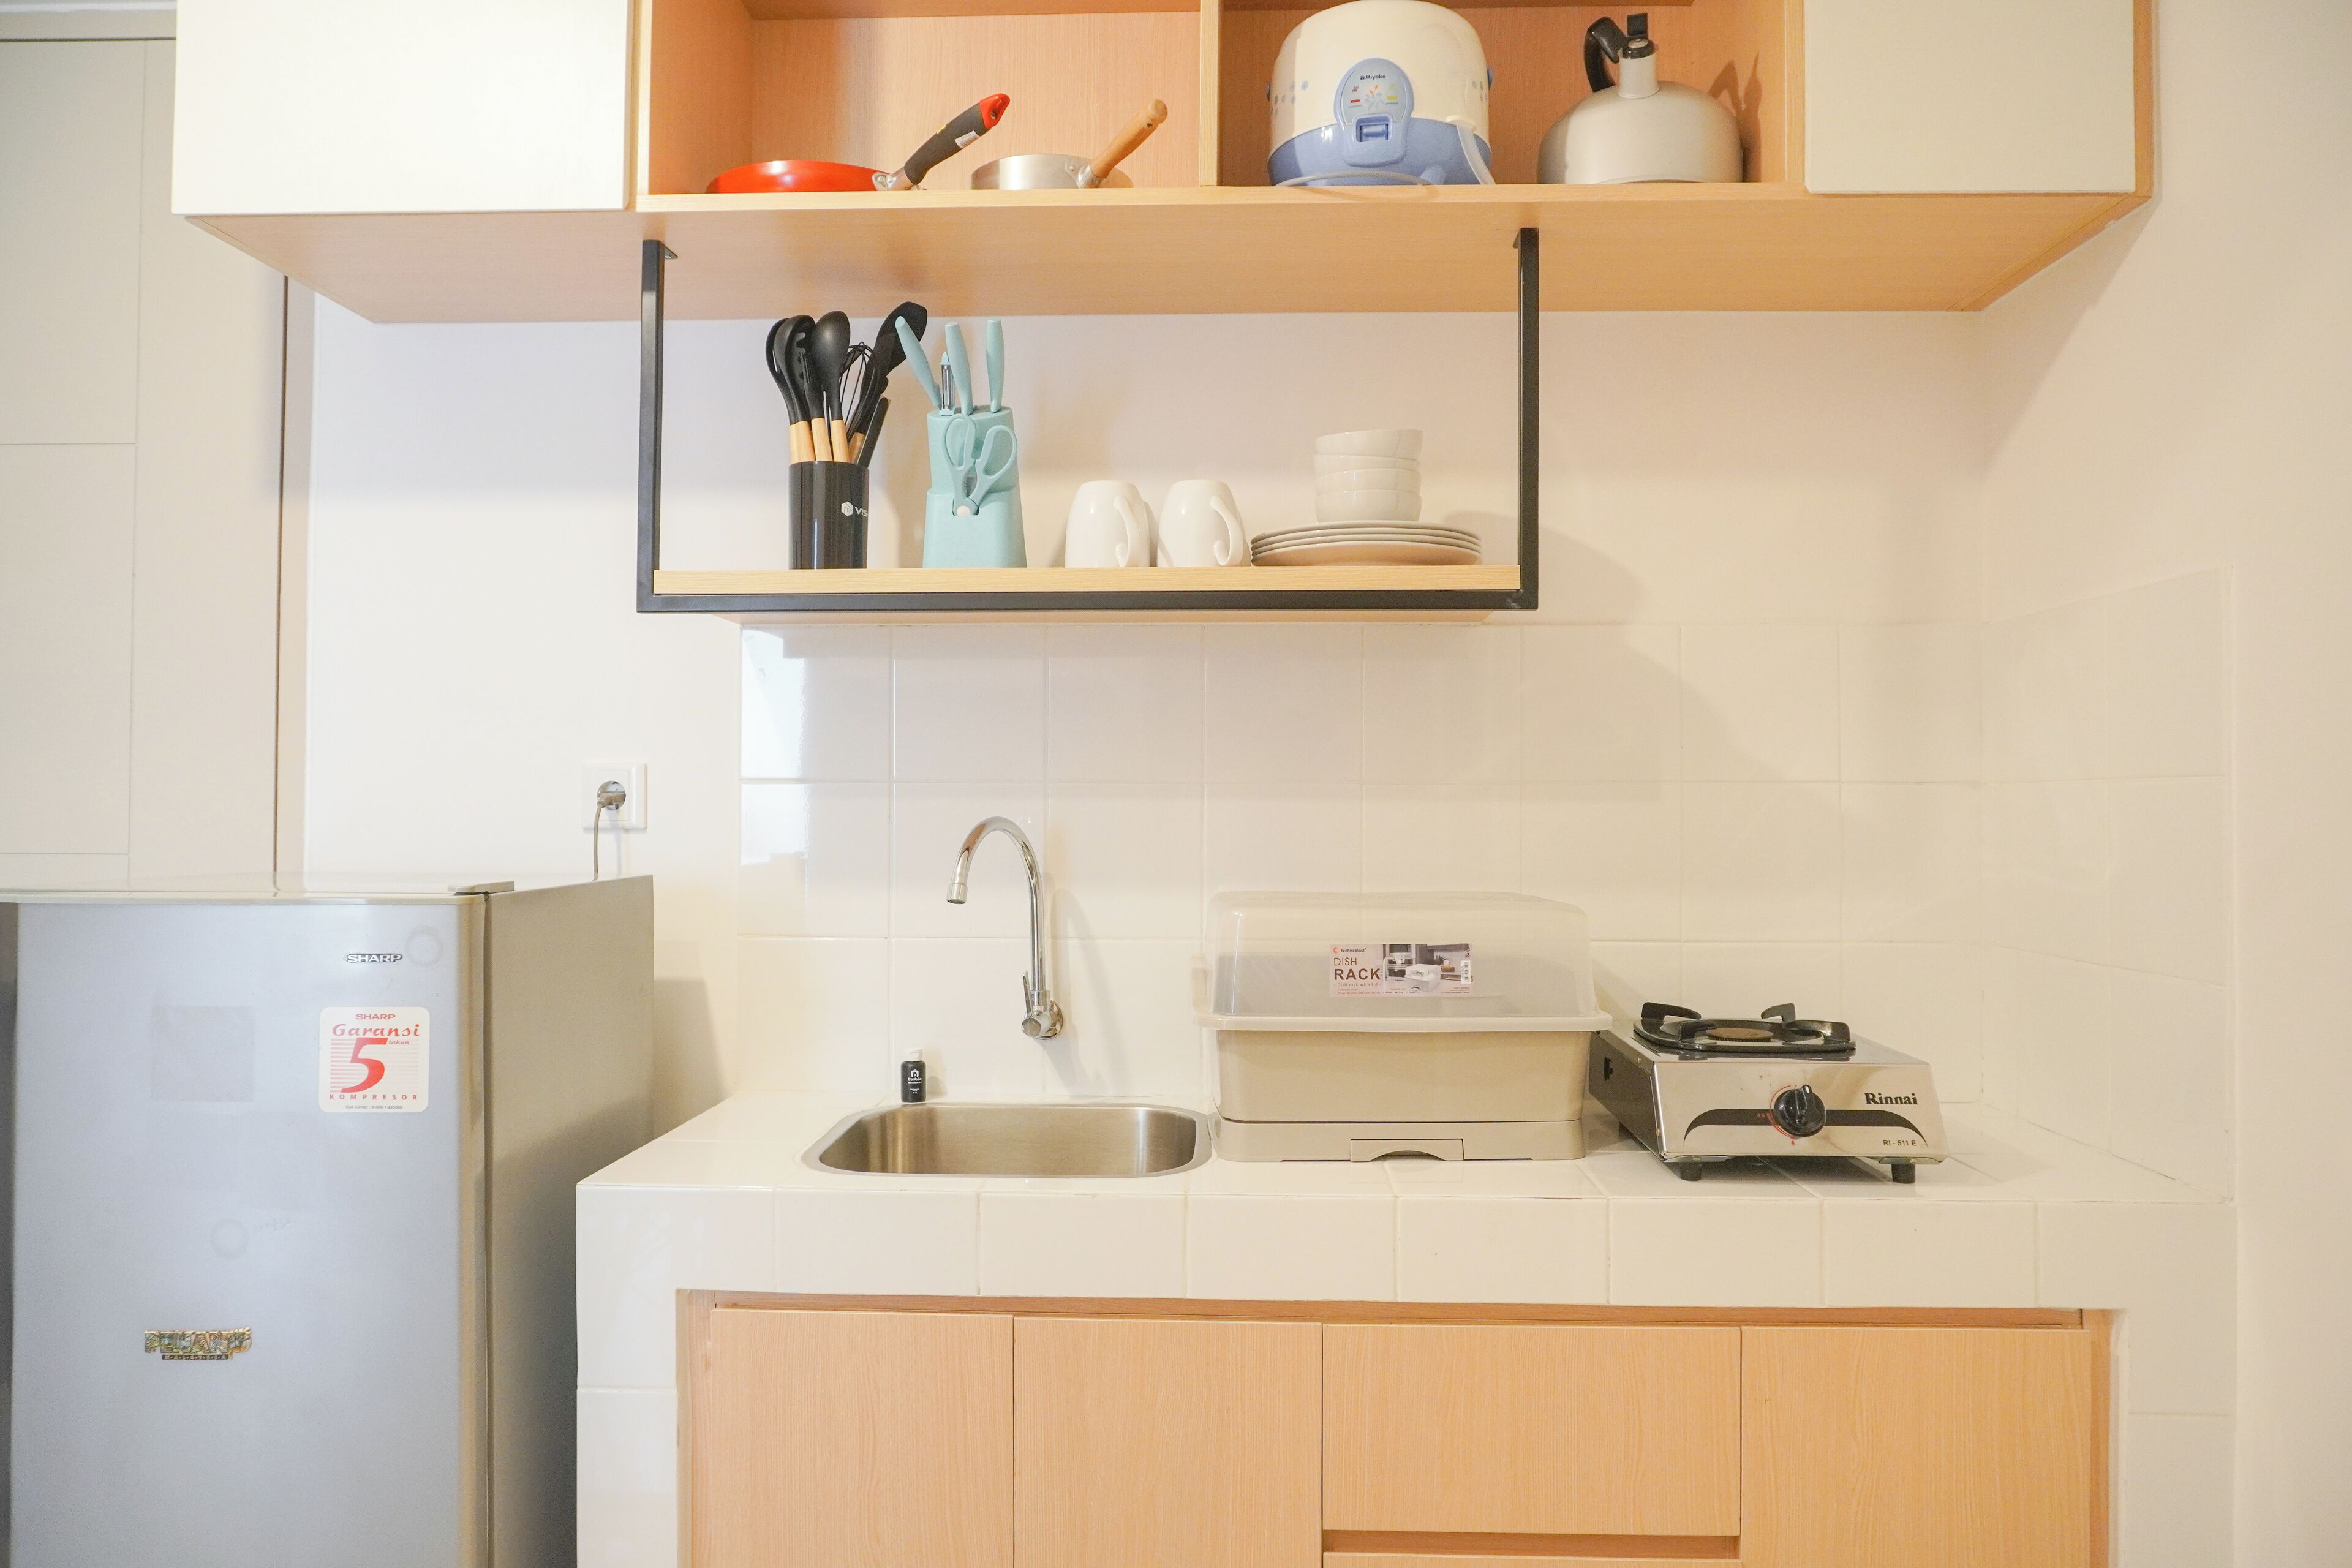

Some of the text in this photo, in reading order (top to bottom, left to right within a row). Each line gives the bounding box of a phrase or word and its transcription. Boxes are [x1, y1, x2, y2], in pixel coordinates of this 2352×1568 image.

[347, 953, 402, 962] SHARP
[1334, 957, 1357, 966] DISH
[1334, 968, 1381, 980] RACK
[332, 1023, 420, 1036] Garansi
[341, 1037, 388, 1093] 5
[1864, 1093, 1918, 1104] Rinnai
